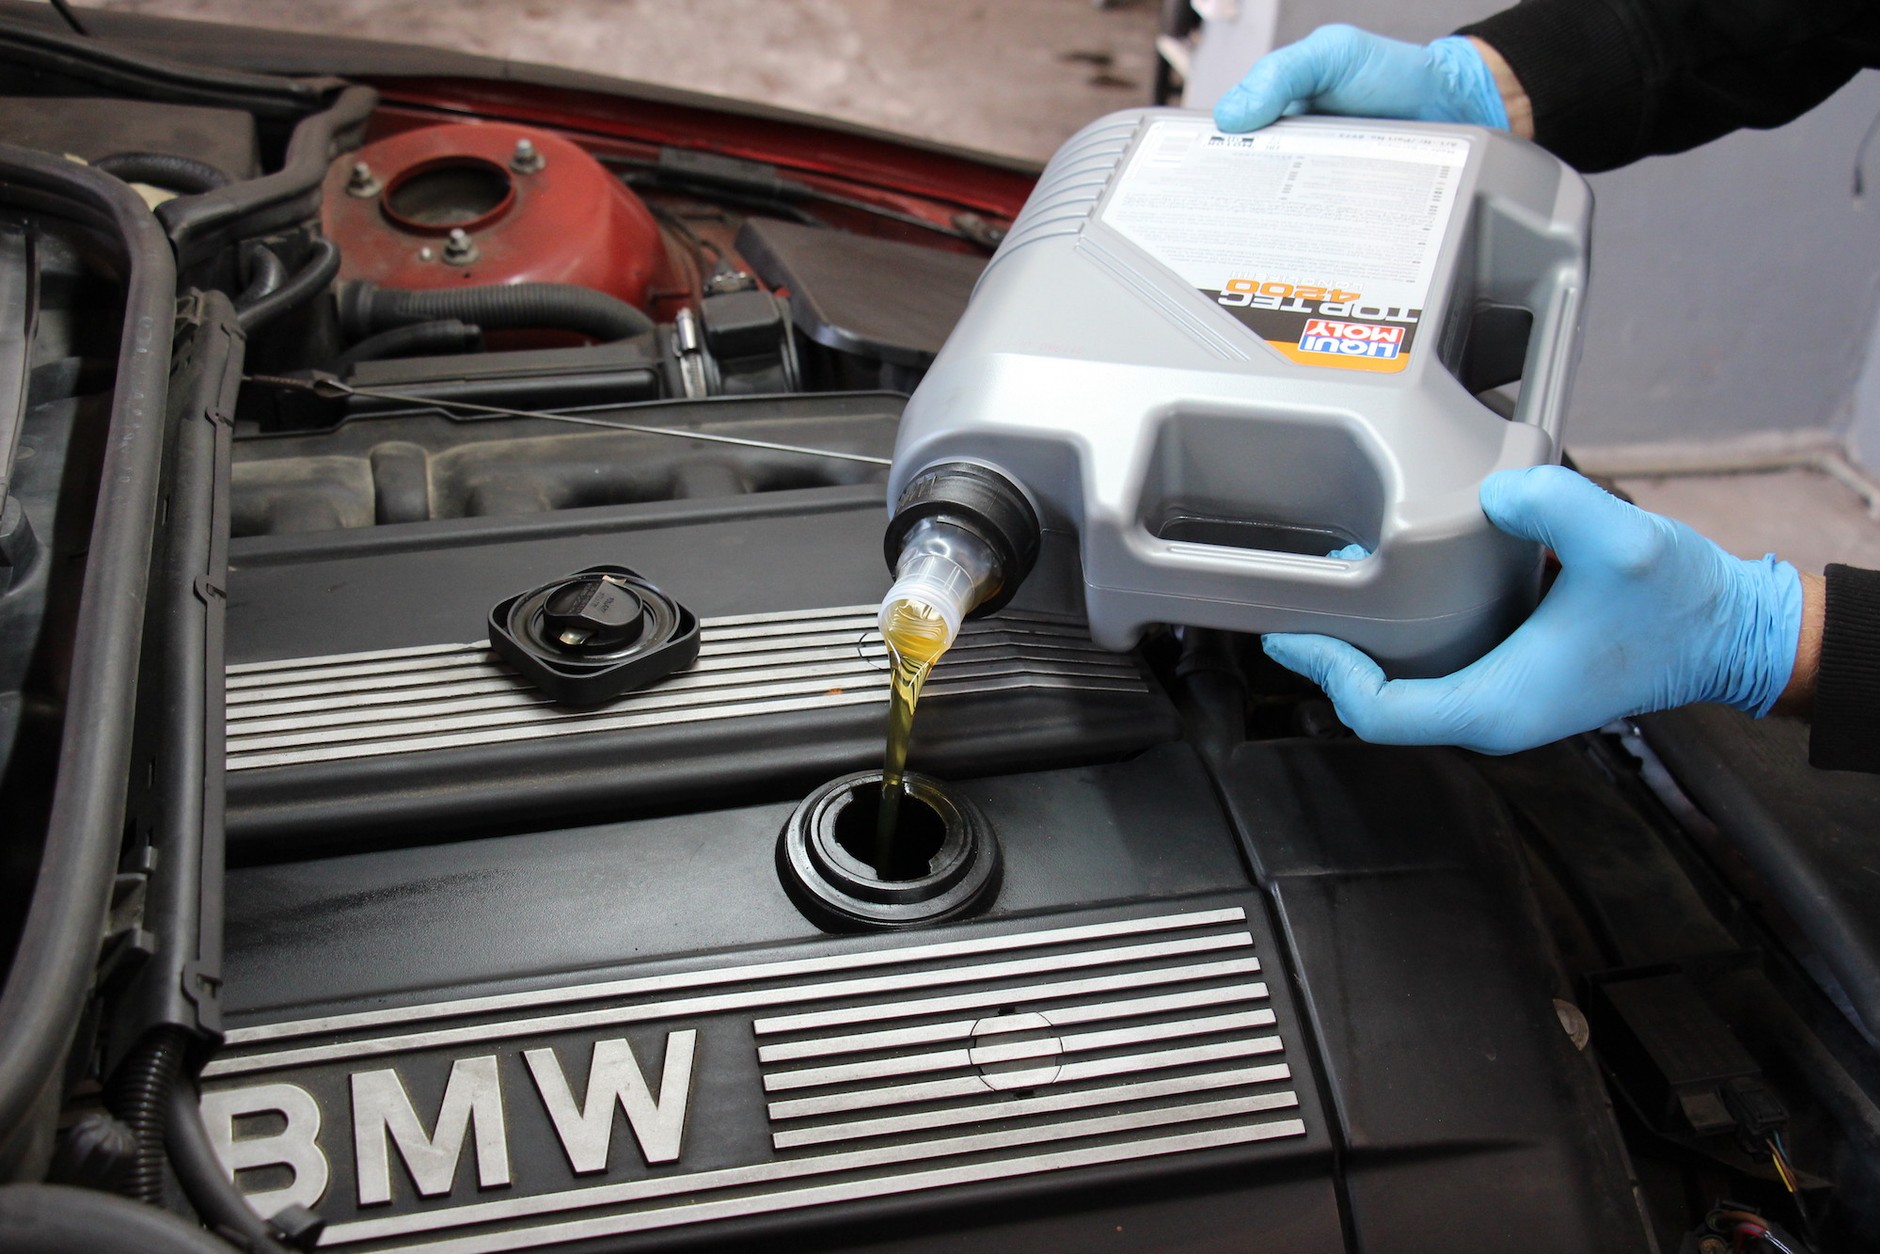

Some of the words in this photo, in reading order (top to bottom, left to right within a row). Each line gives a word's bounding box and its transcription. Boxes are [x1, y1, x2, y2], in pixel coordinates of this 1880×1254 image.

[1217, 289, 1313, 314] TEC
[1225, 278, 1361, 303] 4200
[1318, 299, 1419, 323] TOP
[1308, 322, 1399, 342] MOLY
[1305, 338, 1394, 358] LIQUI
[200, 1028, 698, 1222] BMW
